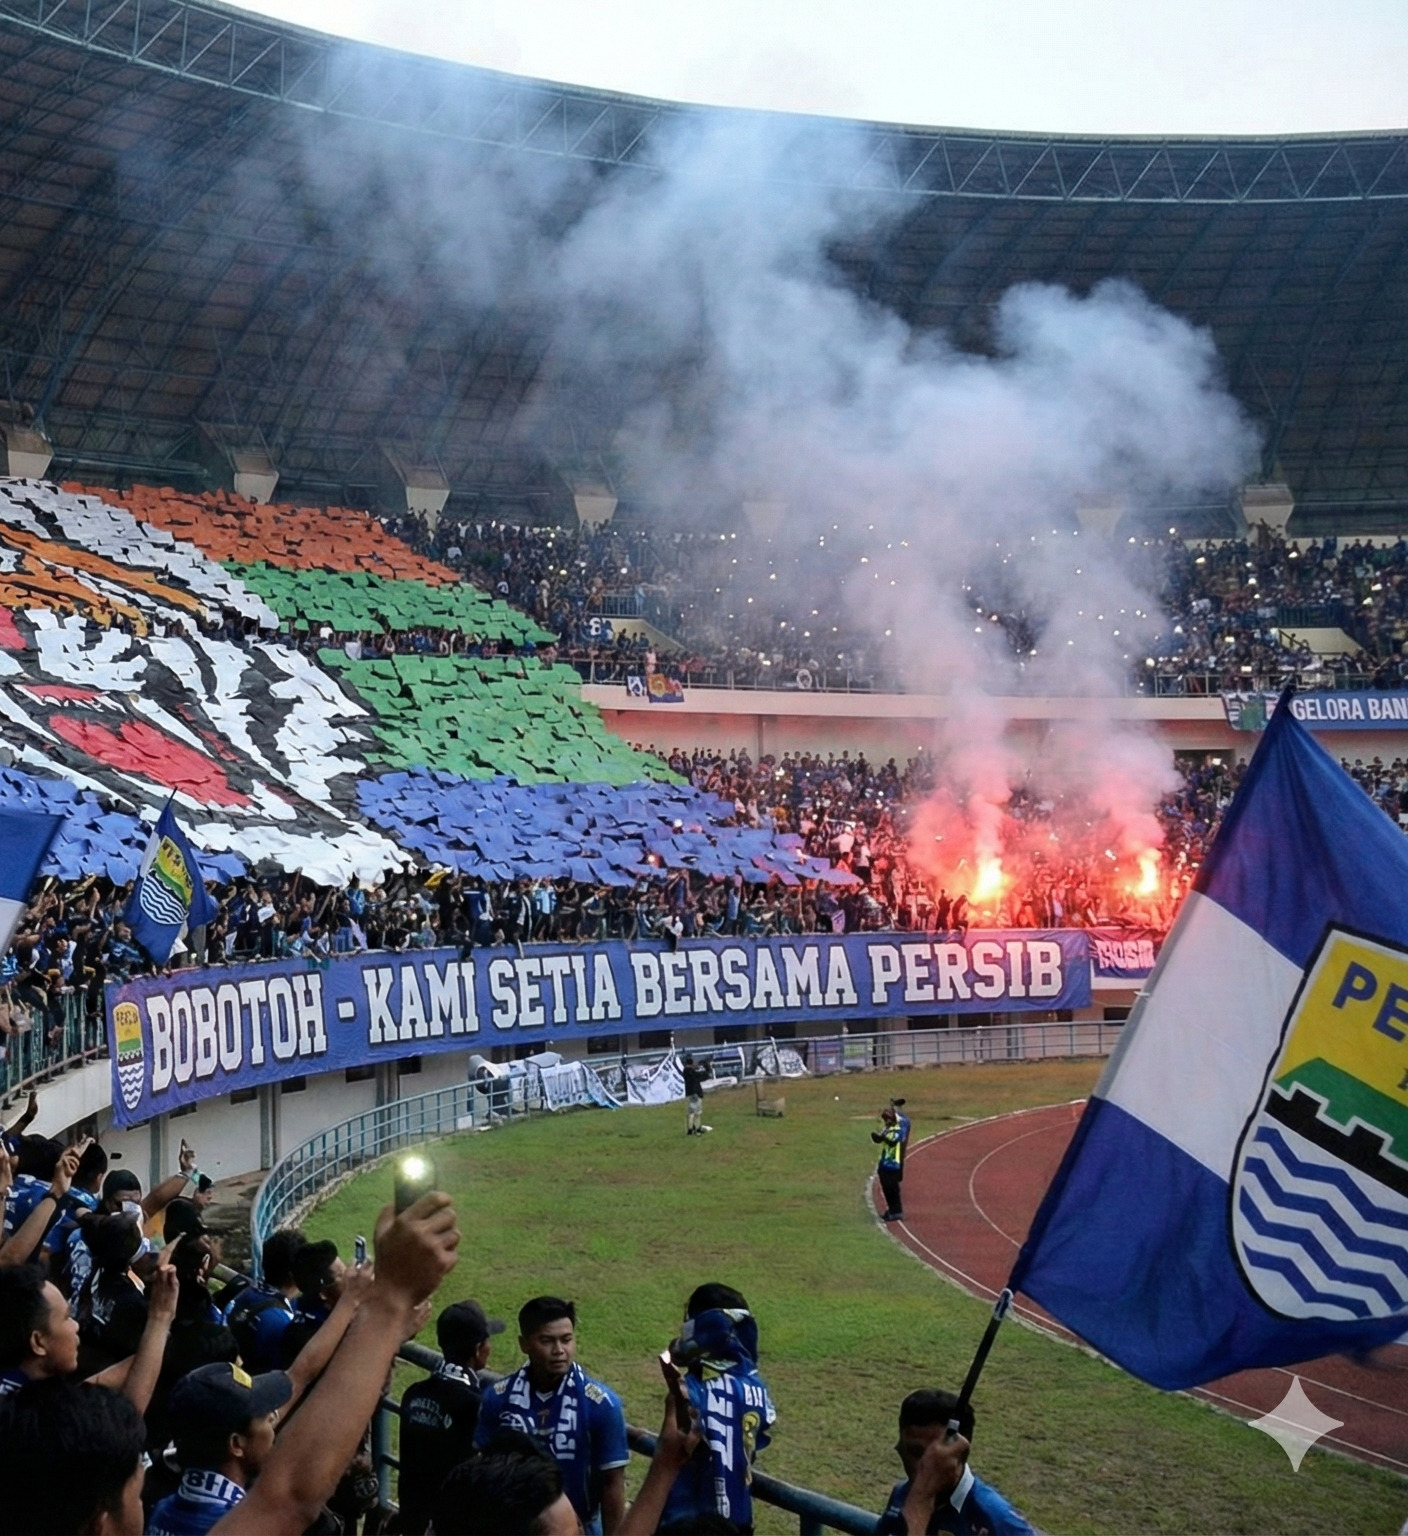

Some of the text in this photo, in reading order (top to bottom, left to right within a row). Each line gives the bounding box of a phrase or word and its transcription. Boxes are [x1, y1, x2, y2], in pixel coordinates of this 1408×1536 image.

[1292, 698, 1408, 720] GELORA BAN
[146, 973, 327, 1092] BOBOTOH
[362, 962, 479, 1043] KAMI
[489, 954, 621, 1029] SETIA
[630, 946, 858, 1017] BERSAMA
[867, 941, 1063, 1004] PERSIB
